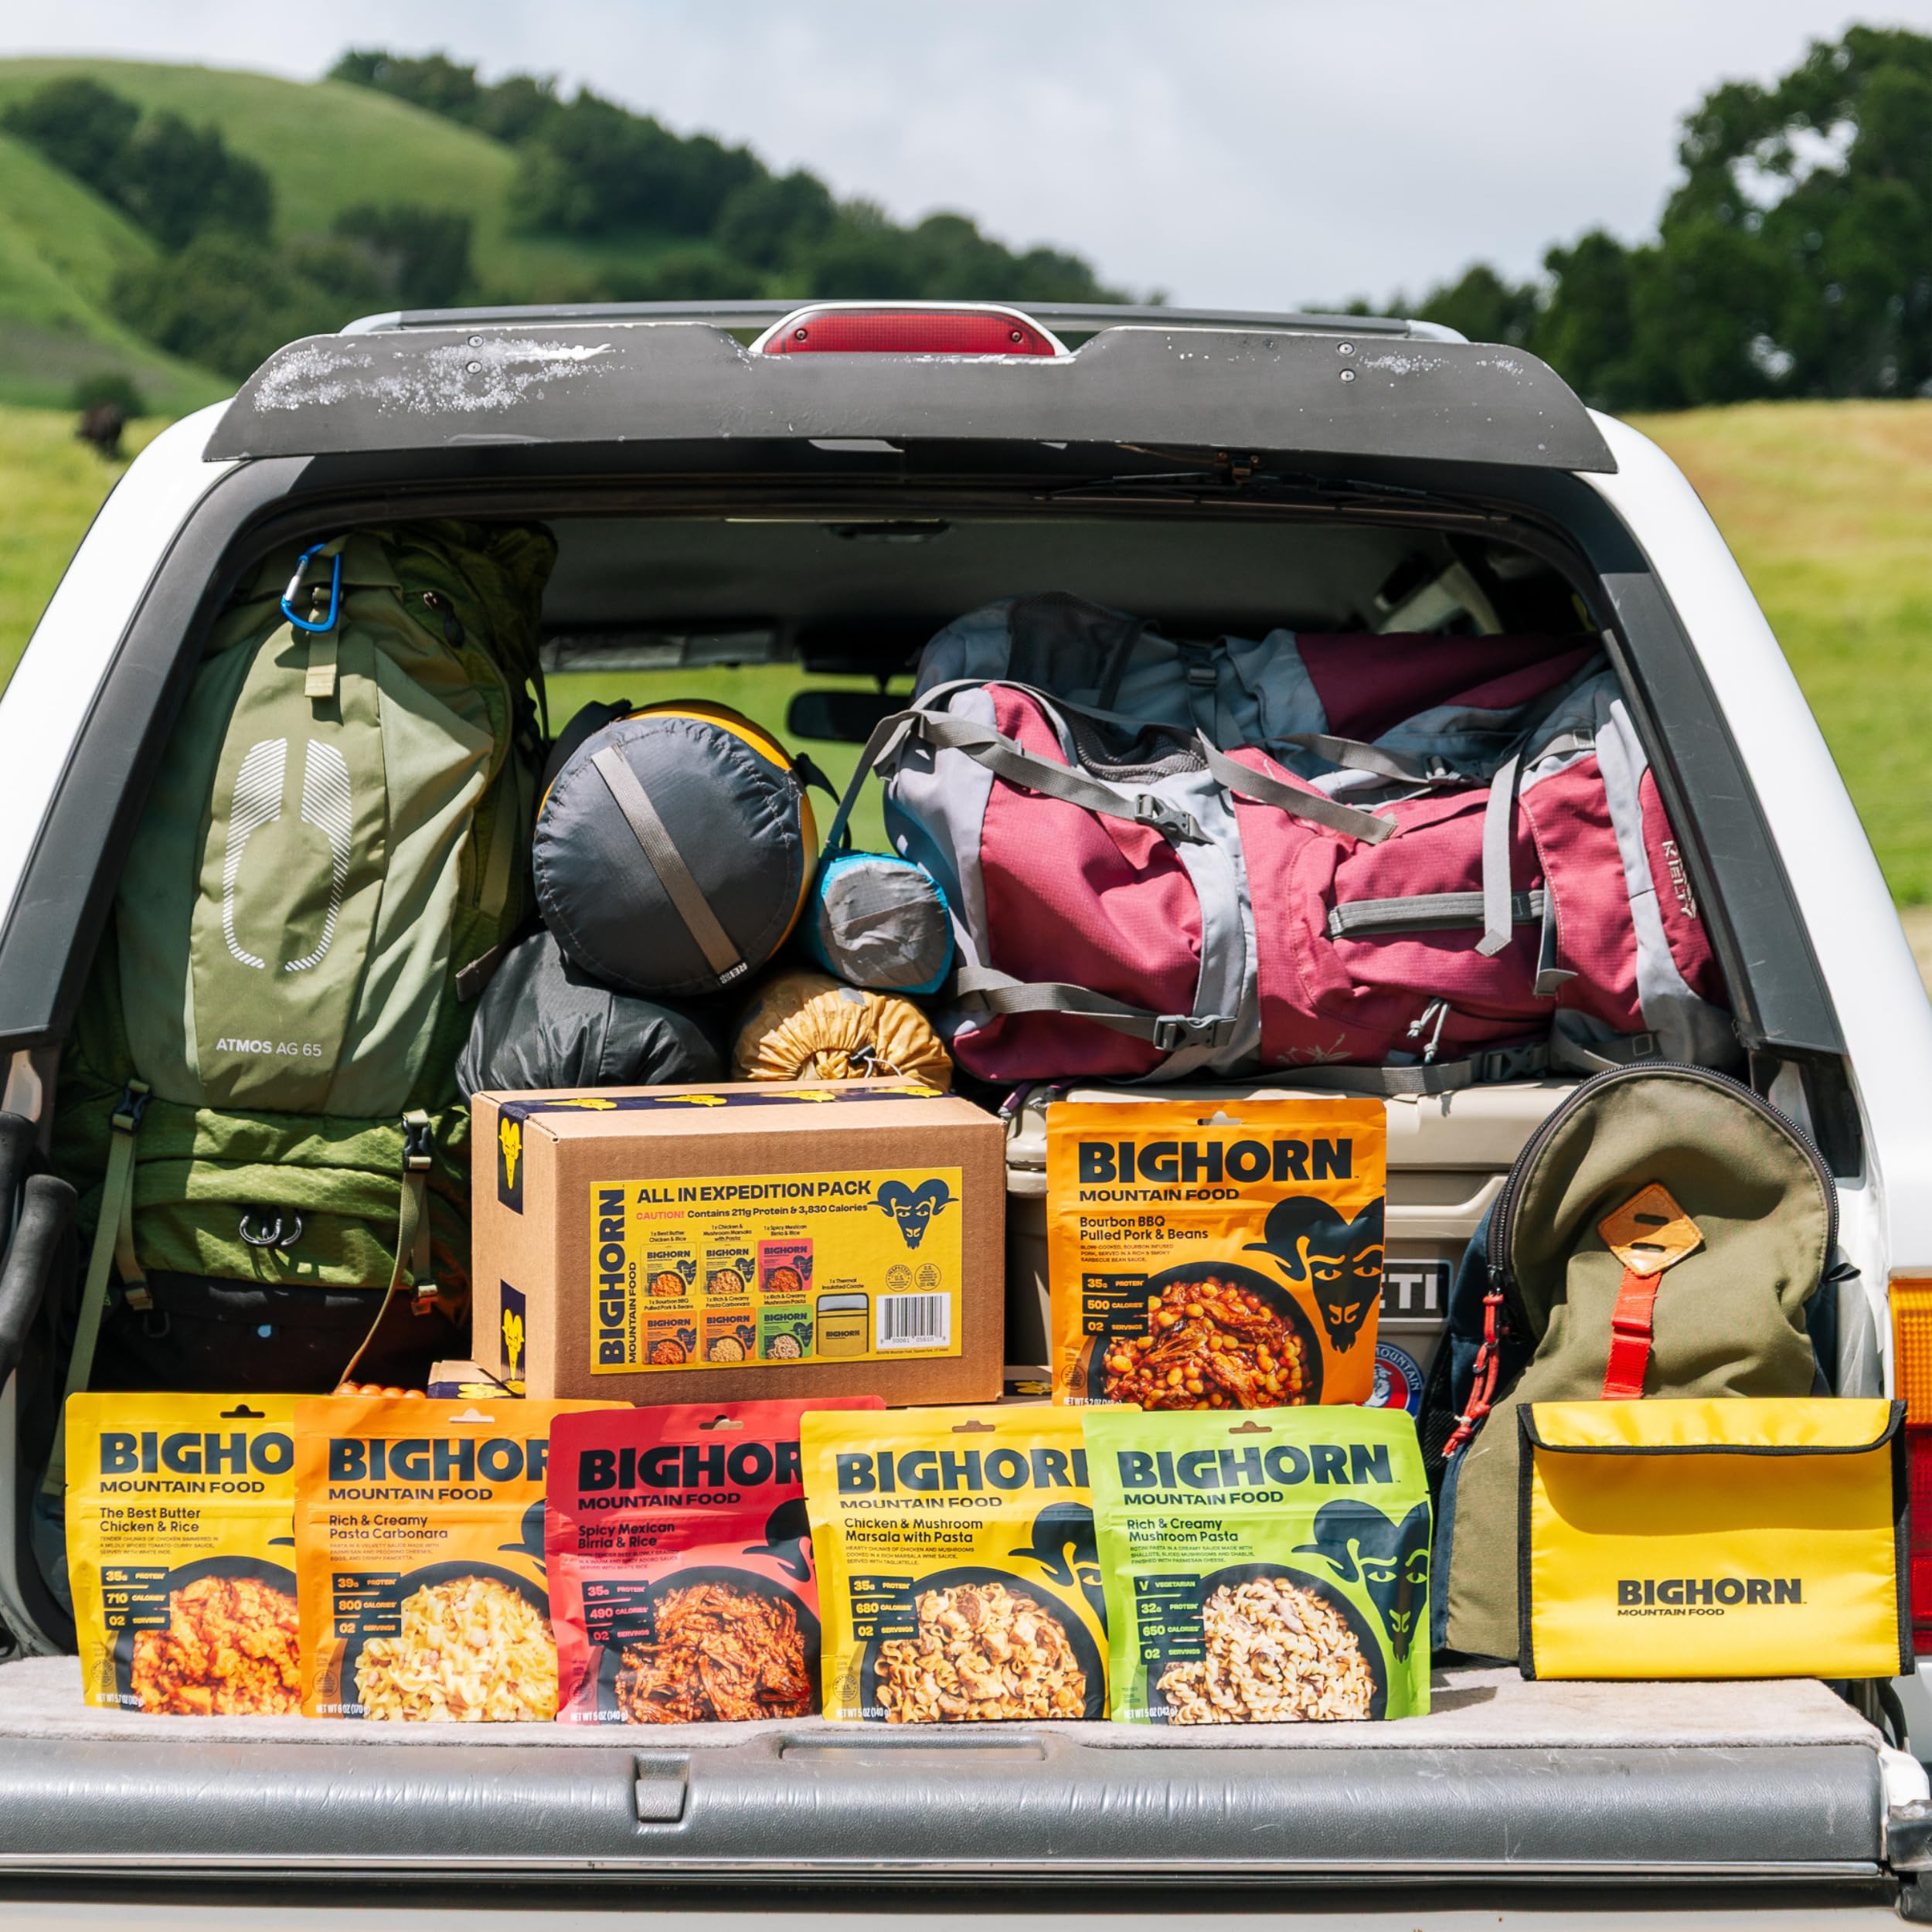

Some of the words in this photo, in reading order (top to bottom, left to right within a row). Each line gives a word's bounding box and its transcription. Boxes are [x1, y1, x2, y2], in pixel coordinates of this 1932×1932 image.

[1662, 840, 1697, 919] KELTY
[216, 1038, 272, 1054] ATMOS
[276, 1043, 298, 1055] AG
[303, 1043, 321, 1057] 65
[1079, 1138, 1352, 1184] BIGHORN
[637, 1189, 675, 1204] ALL
[679, 1187, 696, 1202] IN
[700, 1182, 814, 1201] EXPEDITION
[818, 1181, 872, 1196] PACK
[1080, 1190, 1182, 1202] MOUNTAIN
[1185, 1189, 1240, 1201] FOOD
[636, 1210, 685, 1220] CAUTION!
[688, 1209, 730, 1218] Contains
[731, 1209, 751, 1217] 211g
[753, 1207, 788, 1216] Protein
[799, 1205, 827, 1215] 3,830
[828, 1204, 867, 1213] Calories
[1080, 1216, 1134, 1227] Bourbon
[1138, 1216, 1165, 1227] BBQ
[1080, 1230, 1121, 1240] Pulled
[1124, 1230, 1151, 1240] Pork
[1155, 1229, 1164, 1240] &
[1168, 1229, 1208, 1240] Beans
[764, 1246, 808, 1254] BIGHORN
[598, 1189, 625, 1365] BIGHORN
[1087, 1300, 1110, 1310] 500
[764, 1312, 808, 1321] BIGHORN
[648, 1318, 691, 1327] BIGHORN
[1088, 1321, 1104, 1331] 02
[100, 1432, 294, 1475] BIGHO
[578, 1442, 802, 1492] BIGHOR
[1117, 1444, 1393, 1489] BIGHORN
[100, 1481, 206, 1494] MOUNTAIN
[209, 1481, 265, 1493] FOOD
[328, 1488, 432, 1500] MOUNTAIN
[439, 1488, 493, 1500] FOOD
[1124, 1492, 1227, 1505] MOUNTAIN
[1230, 1491, 1284, 1504] FOOD
[578, 1495, 685, 1510] MOUNTAIN
[686, 1493, 741, 1505] FOOD
[841, 1498, 946, 1509] MOUNTAIN
[949, 1496, 1002, 1507] FOOD
[100, 1508, 124, 1518] The
[127, 1508, 156, 1518] Best
[160, 1508, 201, 1518] Butter
[100, 1521, 154, 1532] Chicken
[158, 1521, 166, 1532] &
[171, 1521, 199, 1532] Rice
[329, 1515, 357, 1526] Rich
[361, 1515, 369, 1526] &
[374, 1515, 428, 1527] Creamy
[845, 1518, 897, 1529] Chicken
[901, 1519, 909, 1529] &
[913, 1519, 983, 1529] Mushroom
[1127, 1519, 1155, 1530] Rich
[1159, 1519, 1167, 1529] &
[1170, 1518, 1223, 1531] Creamy
[330, 1529, 369, 1539] Pasta
[372, 1529, 448, 1539] Carbonara
[579, 1526, 615, 1536] Spicy
[618, 1522, 675, 1535] Mexican
[845, 1530, 900, 1543] Marsala
[903, 1532, 930, 1543] with
[935, 1532, 972, 1543] Pasta
[1129, 1532, 1197, 1543] Mushroom
[1200, 1532, 1238, 1543] Pasta
[578, 1538, 614, 1549] Birria
[617, 1538, 625, 1548] &
[629, 1536, 657, 1547] Rice
[1139, 1581, 1149, 1590] V
[1617, 1578, 1802, 1606] BIGHORN
[107, 1594, 128, 1604] 710
[338, 1600, 362, 1611] 800
[856, 1603, 879, 1614] 680
[590, 1608, 614, 1618] 490
[109, 1615, 125, 1626] 02
[340, 1623, 355, 1634] 02
[858, 1626, 873, 1637] 02
[1142, 1626, 1165, 1637] 650
[594, 1631, 609, 1641] 02
[1145, 1649, 1161, 1659] 02
